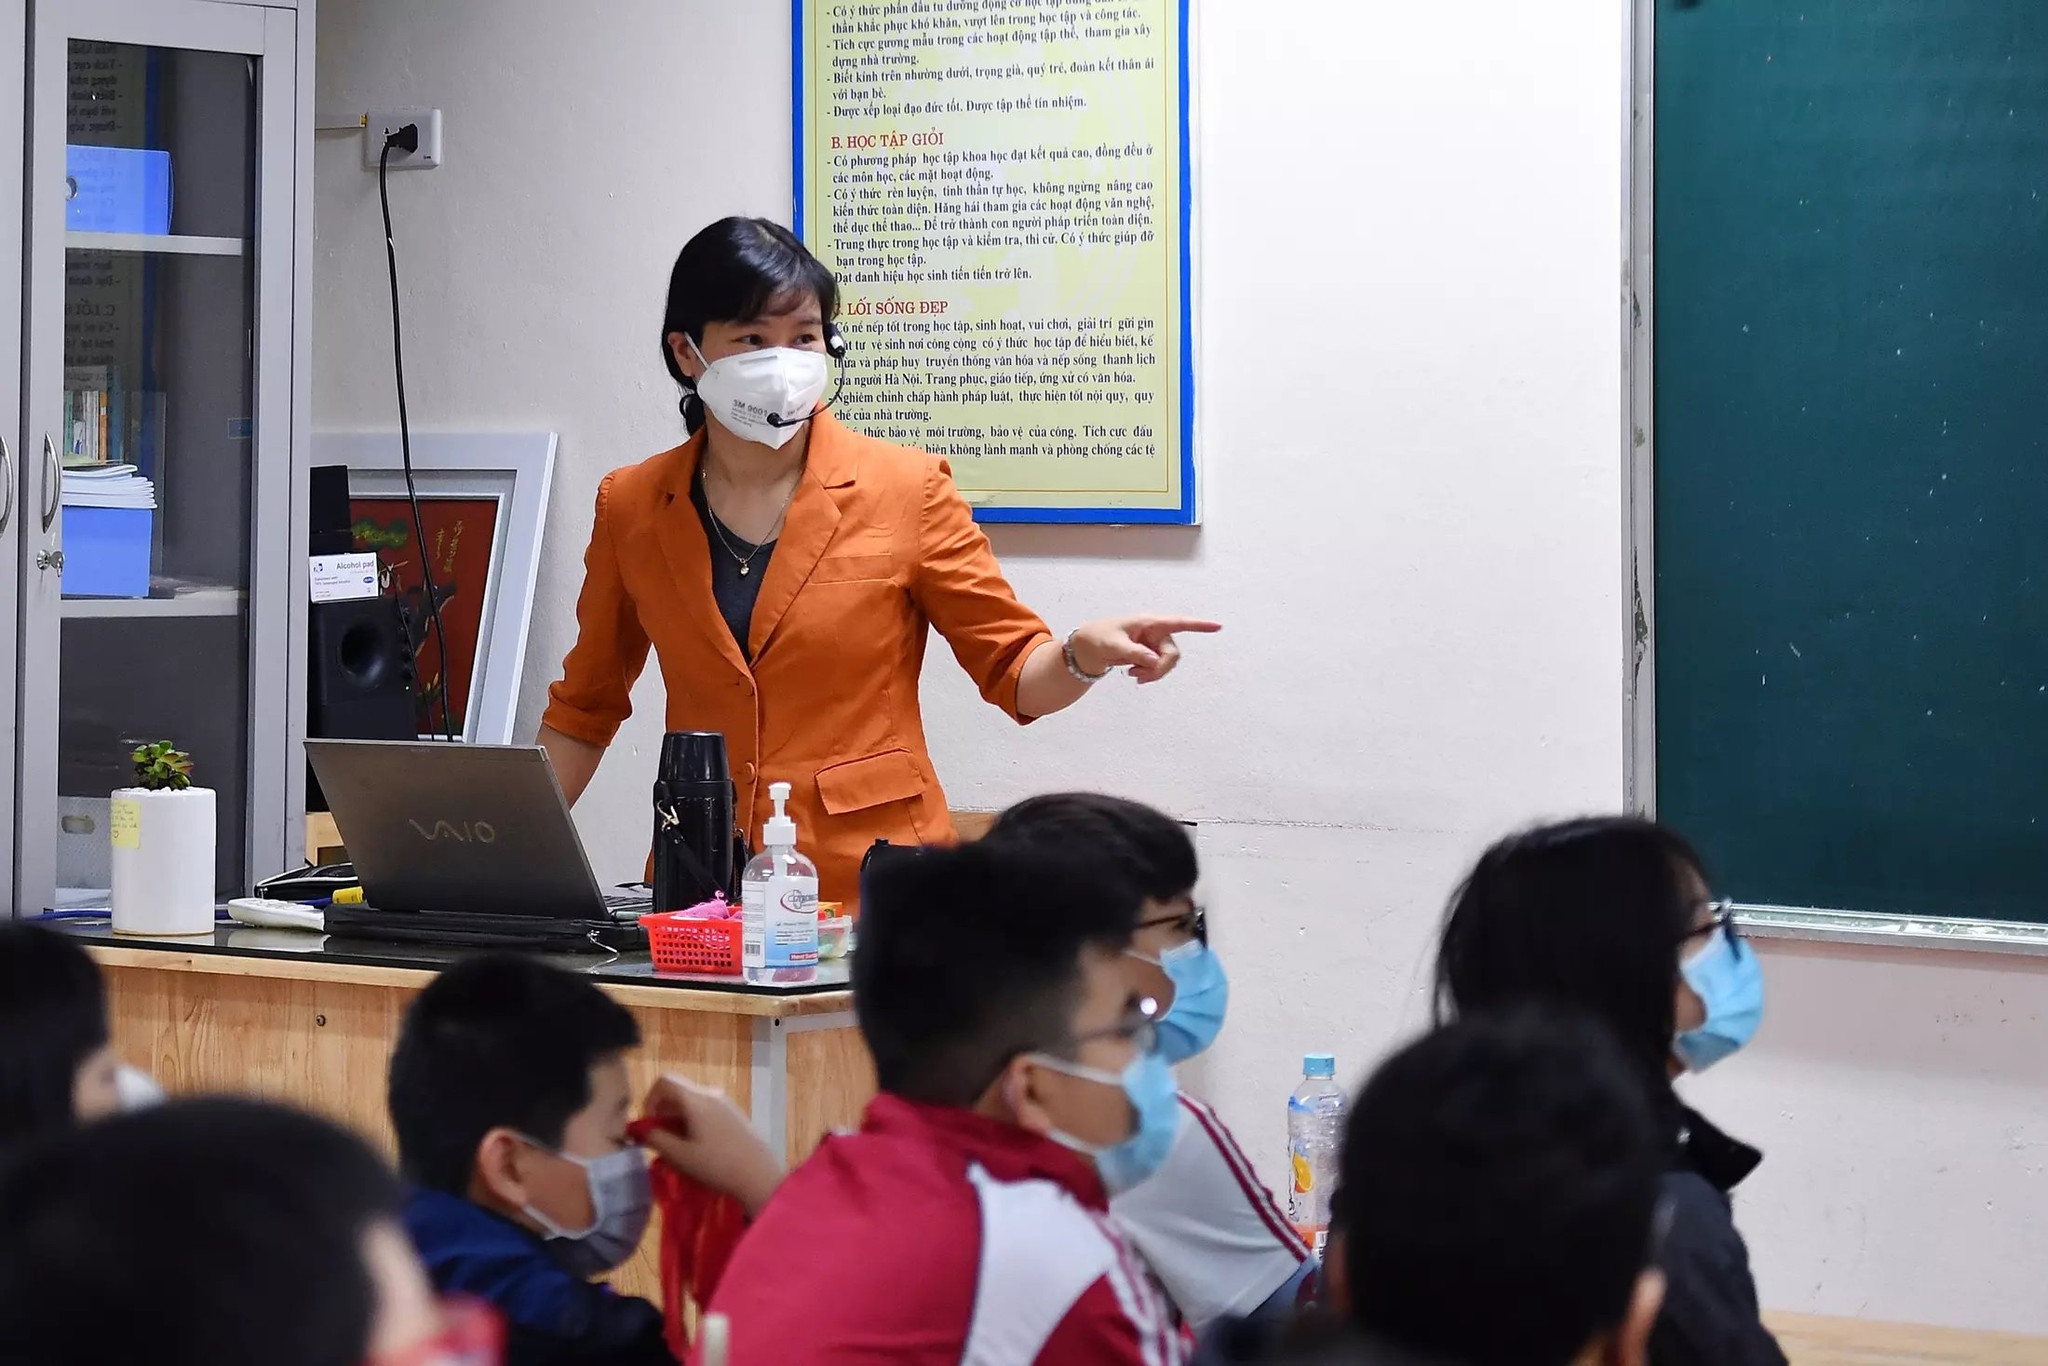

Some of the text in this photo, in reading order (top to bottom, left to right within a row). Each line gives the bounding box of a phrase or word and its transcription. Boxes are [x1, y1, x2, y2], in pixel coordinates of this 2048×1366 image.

[831, 137, 842, 149] B.
[846, 136, 876, 152] HỌC
[879, 130, 908, 150] TẬP
[847, 296, 948, 317] LỐI SỐNG ĐẸP
[336, 561, 361, 570] Alcohol
[408, 818, 495, 844] VAIO
